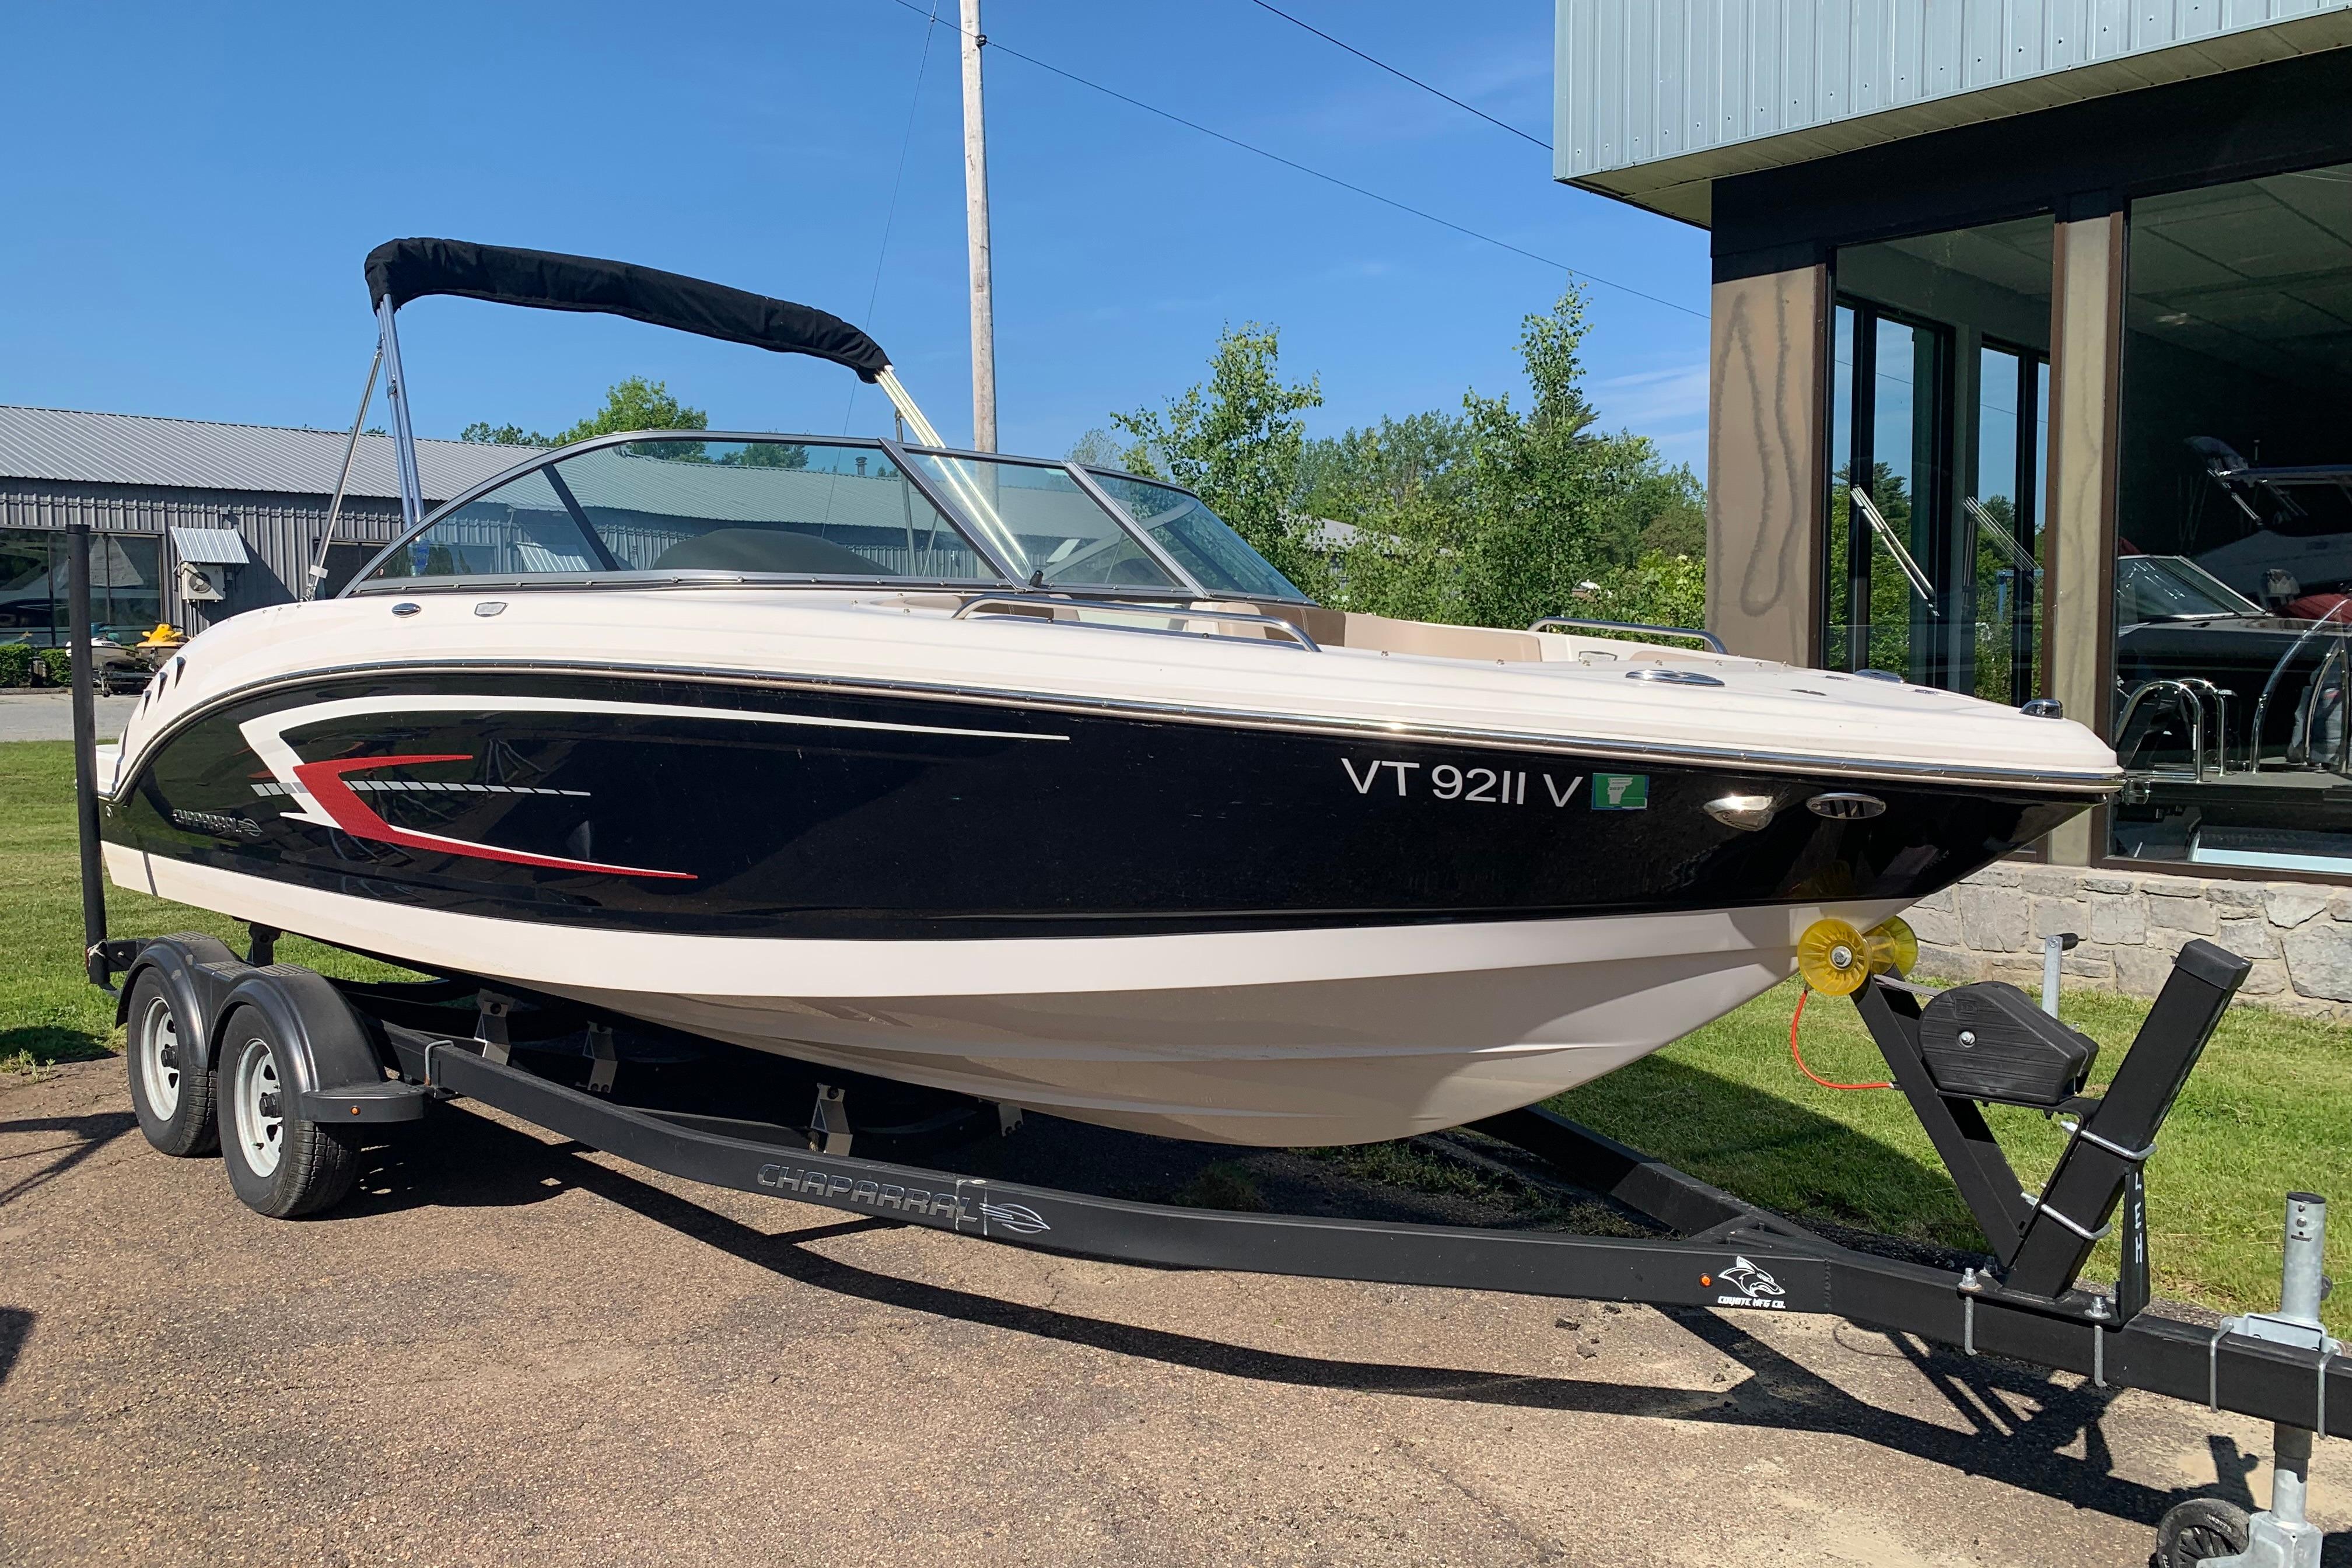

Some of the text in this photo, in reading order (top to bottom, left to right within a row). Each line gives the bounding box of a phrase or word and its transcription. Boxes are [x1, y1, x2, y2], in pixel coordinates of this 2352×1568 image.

[1341, 758, 1583, 807] VT 9211 V
[758, 1164, 978, 1223] CHAPARRAL
[1717, 1296, 1752, 1306] COYOTE
[1752, 1298, 1772, 1308] MFG
